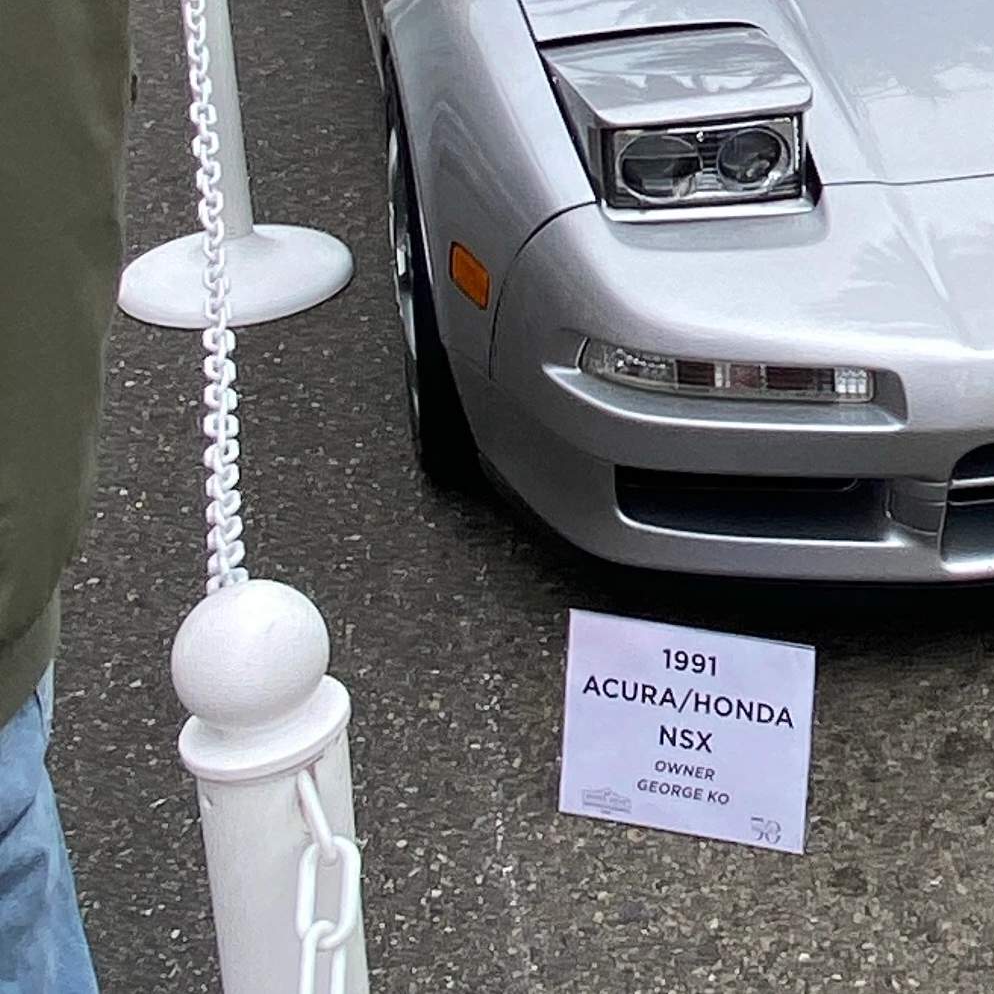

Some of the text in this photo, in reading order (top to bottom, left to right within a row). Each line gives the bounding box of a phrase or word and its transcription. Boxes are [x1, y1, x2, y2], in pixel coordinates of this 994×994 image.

[662, 649, 717, 677] 1991
[582, 675, 794, 729] ACURA/HONDA
[659, 724, 713, 754] NSX
[654, 760, 716, 782] OWNER
[637, 778, 704, 802] GEORGE
[707, 790, 731, 805] KO
